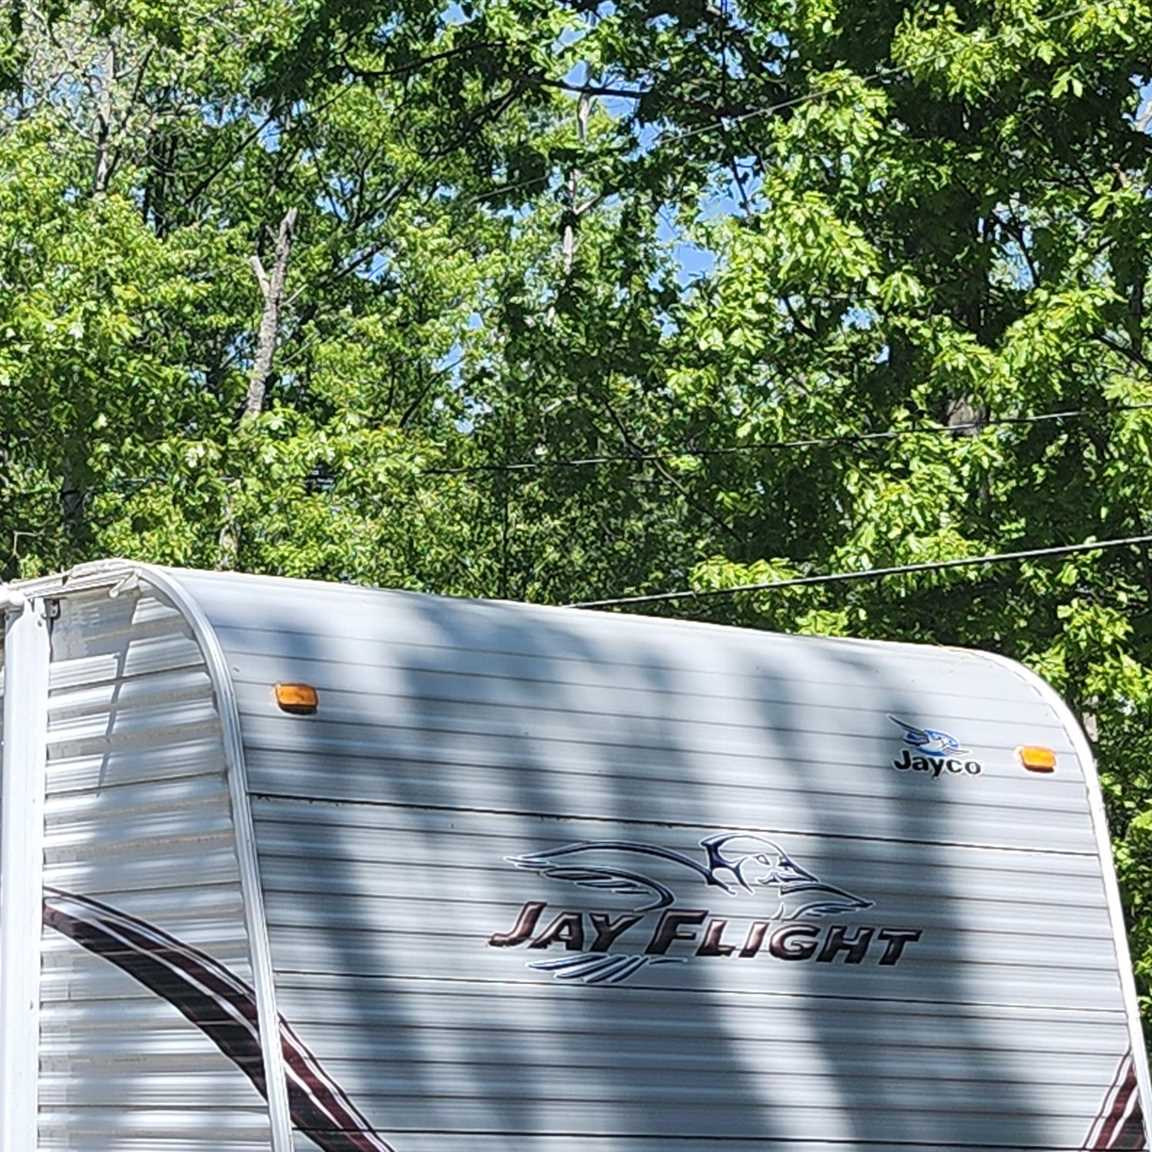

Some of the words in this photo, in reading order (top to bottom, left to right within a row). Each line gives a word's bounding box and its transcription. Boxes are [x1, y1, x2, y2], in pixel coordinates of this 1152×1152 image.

[893, 749, 982, 778] Jayco
[487, 900, 645, 952] JAY
[644, 908, 923, 966] FLIGHT
